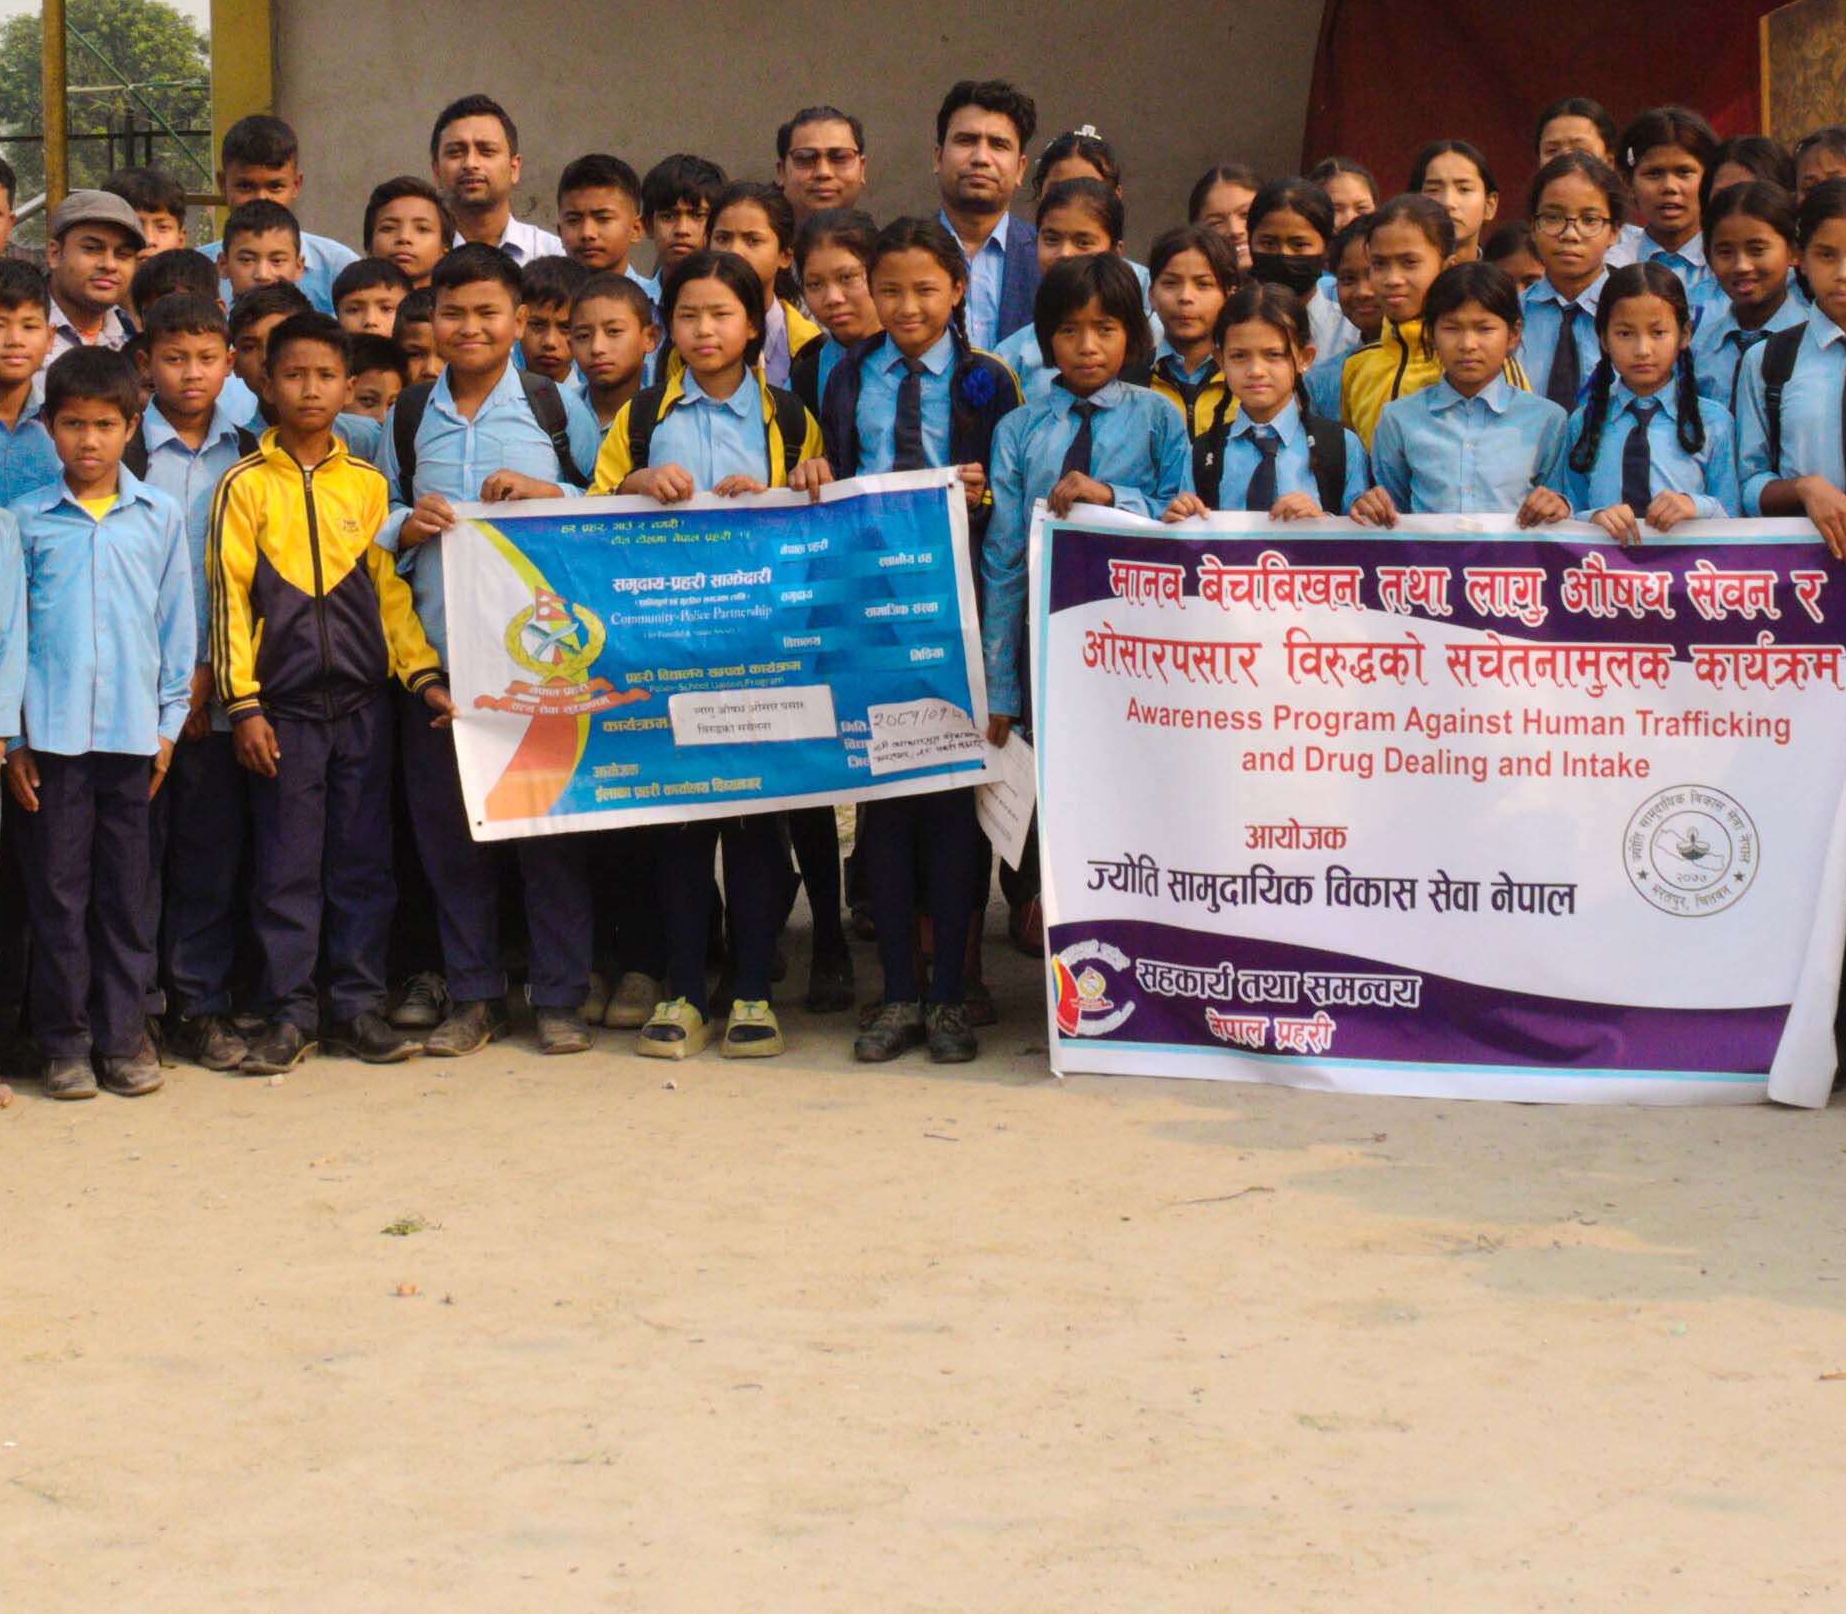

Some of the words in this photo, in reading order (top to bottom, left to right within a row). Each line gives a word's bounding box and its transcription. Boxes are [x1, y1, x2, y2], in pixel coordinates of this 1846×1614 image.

[712, 603, 774, 622] Partnership
[1108, 559, 1187, 610] मानव
[1197, 551, 1367, 611] बेचबिखन
[1376, 566, 1454, 616] तथा
[1464, 568, 1549, 627] लागु
[1561, 551, 1677, 619] औषध
[1685, 560, 1781, 621] सेवन
[1791, 569, 1829, 624] र
[1082, 621, 1263, 686] ओसारपसार
[1282, 626, 1429, 688] विरुद्धको
[1445, 632, 1675, 698] सचेतनामुलक
[1689, 631, 1846, 690] कार्यक्रम
[1126, 697, 1262, 730] Awareness
[1273, 705, 1396, 738] Program
[1404, 706, 1513, 740] Against
[1523, 708, 1626, 736] Human
[1636, 710, 1791, 745] Trafficking
[1242, 746, 1295, 772] and
[1305, 746, 1374, 779] Drug
[1384, 747, 1489, 783] Dealing
[1499, 751, 1552, 778] and
[1562, 751, 1651, 778] Intake
[1244, 818, 1349, 850] आयोजक
[1087, 852, 1160, 897] ज्योति
[1168, 864, 1315, 913] सामुदायिक
[1325, 864, 1419, 911] विकास
[1428, 868, 1481, 913] सेवा
[1491, 871, 1578, 916] नेपाल
[1136, 959, 1234, 1001] सहकार्य
[1237, 970, 1301, 1004] तथा
[1302, 971, 1424, 1009] समन्वय
[1205, 1006, 1268, 1049] नेपाल
[1274, 1010, 1337, 1054] प्रहरी
